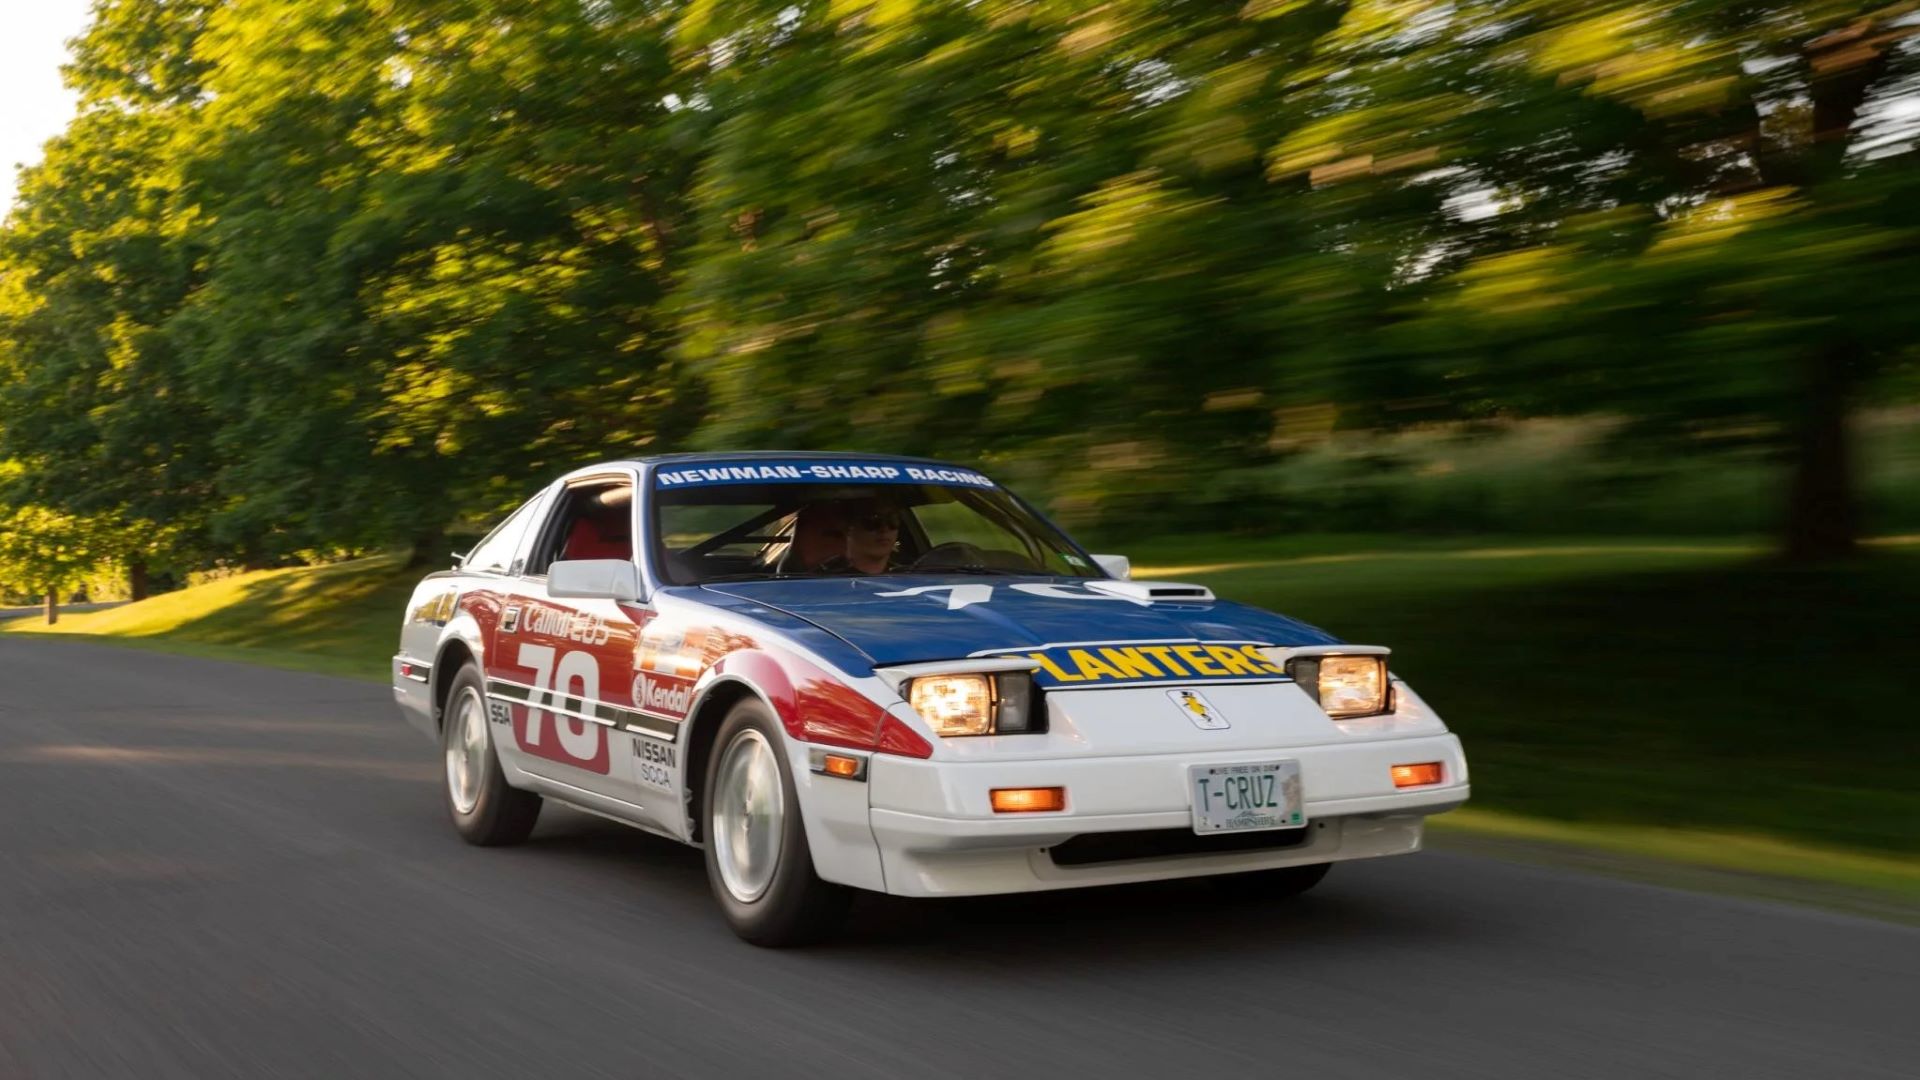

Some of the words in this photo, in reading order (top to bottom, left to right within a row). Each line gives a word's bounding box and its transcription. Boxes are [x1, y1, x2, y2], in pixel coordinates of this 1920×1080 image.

[657, 465, 900, 485] NEWMAN-SHARP
[905, 468, 994, 487] RACING
[1000, 645, 1284, 682] LANTERS
[518, 643, 600, 761] 70
[646, 678, 692, 713] Kendall
[632, 738, 676, 768] NISSAN
[641, 763, 672, 788] SCCA
[1198, 774, 1278, 812] T-CRUZ
